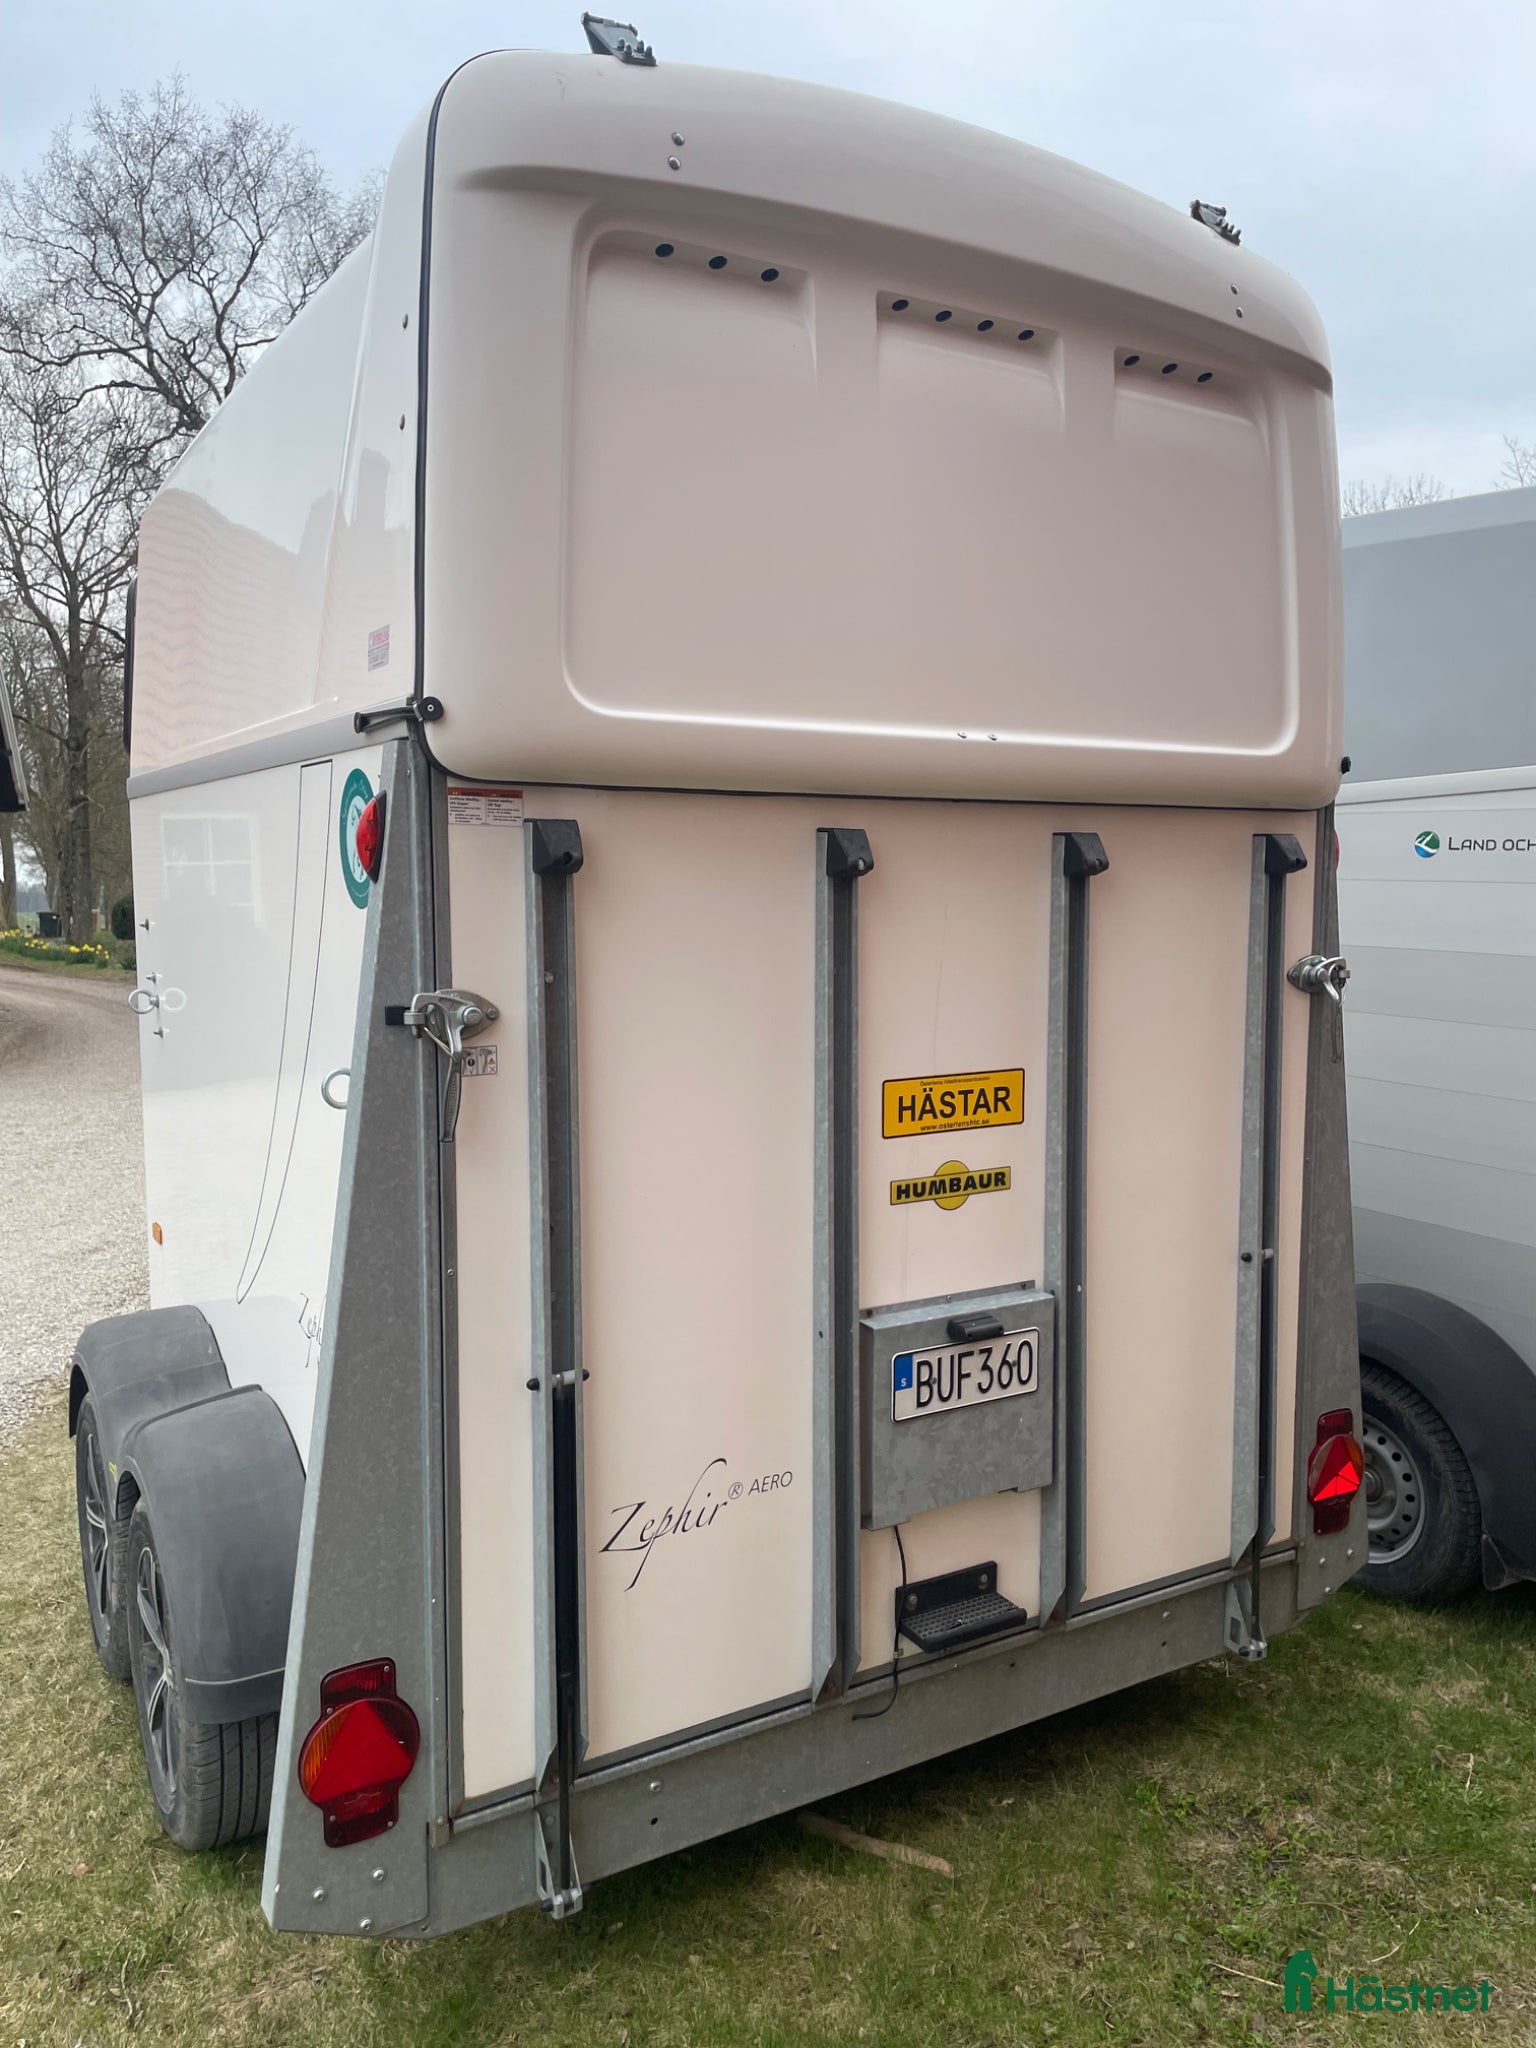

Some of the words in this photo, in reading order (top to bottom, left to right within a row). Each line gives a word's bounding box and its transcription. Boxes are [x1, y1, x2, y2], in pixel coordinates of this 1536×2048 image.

[898, 1086, 1011, 1123] HÄSTAR
[896, 1171, 1007, 1200] HUMBAUR
[900, 1377, 907, 1387] S
[748, 1471, 793, 1495] AERO
